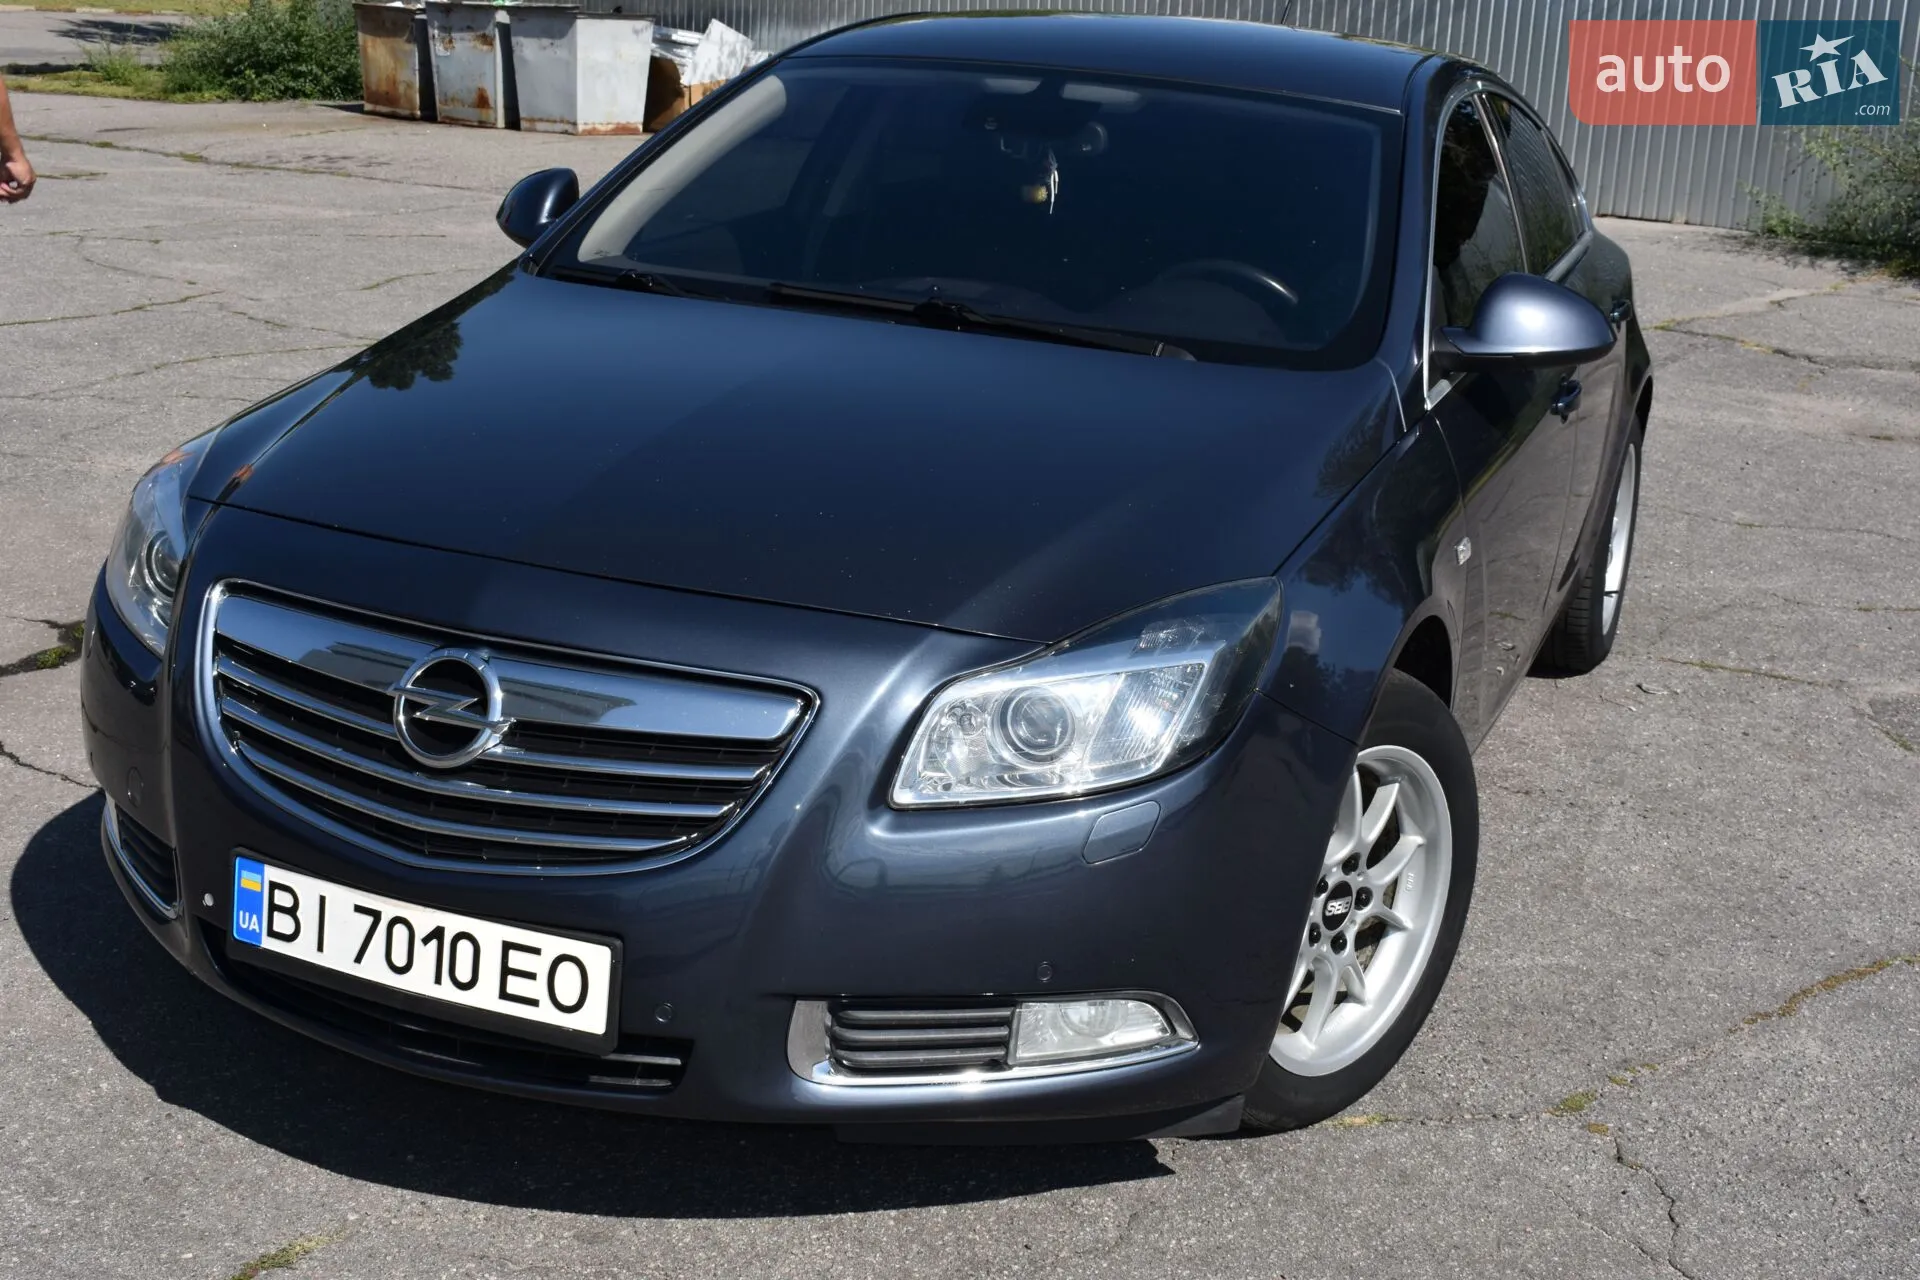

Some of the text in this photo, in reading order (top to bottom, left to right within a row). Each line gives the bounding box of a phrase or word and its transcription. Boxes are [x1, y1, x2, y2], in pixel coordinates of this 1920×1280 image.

[238, 910, 260, 934] UA
[266, 880, 589, 1015] BI 7010 EO
